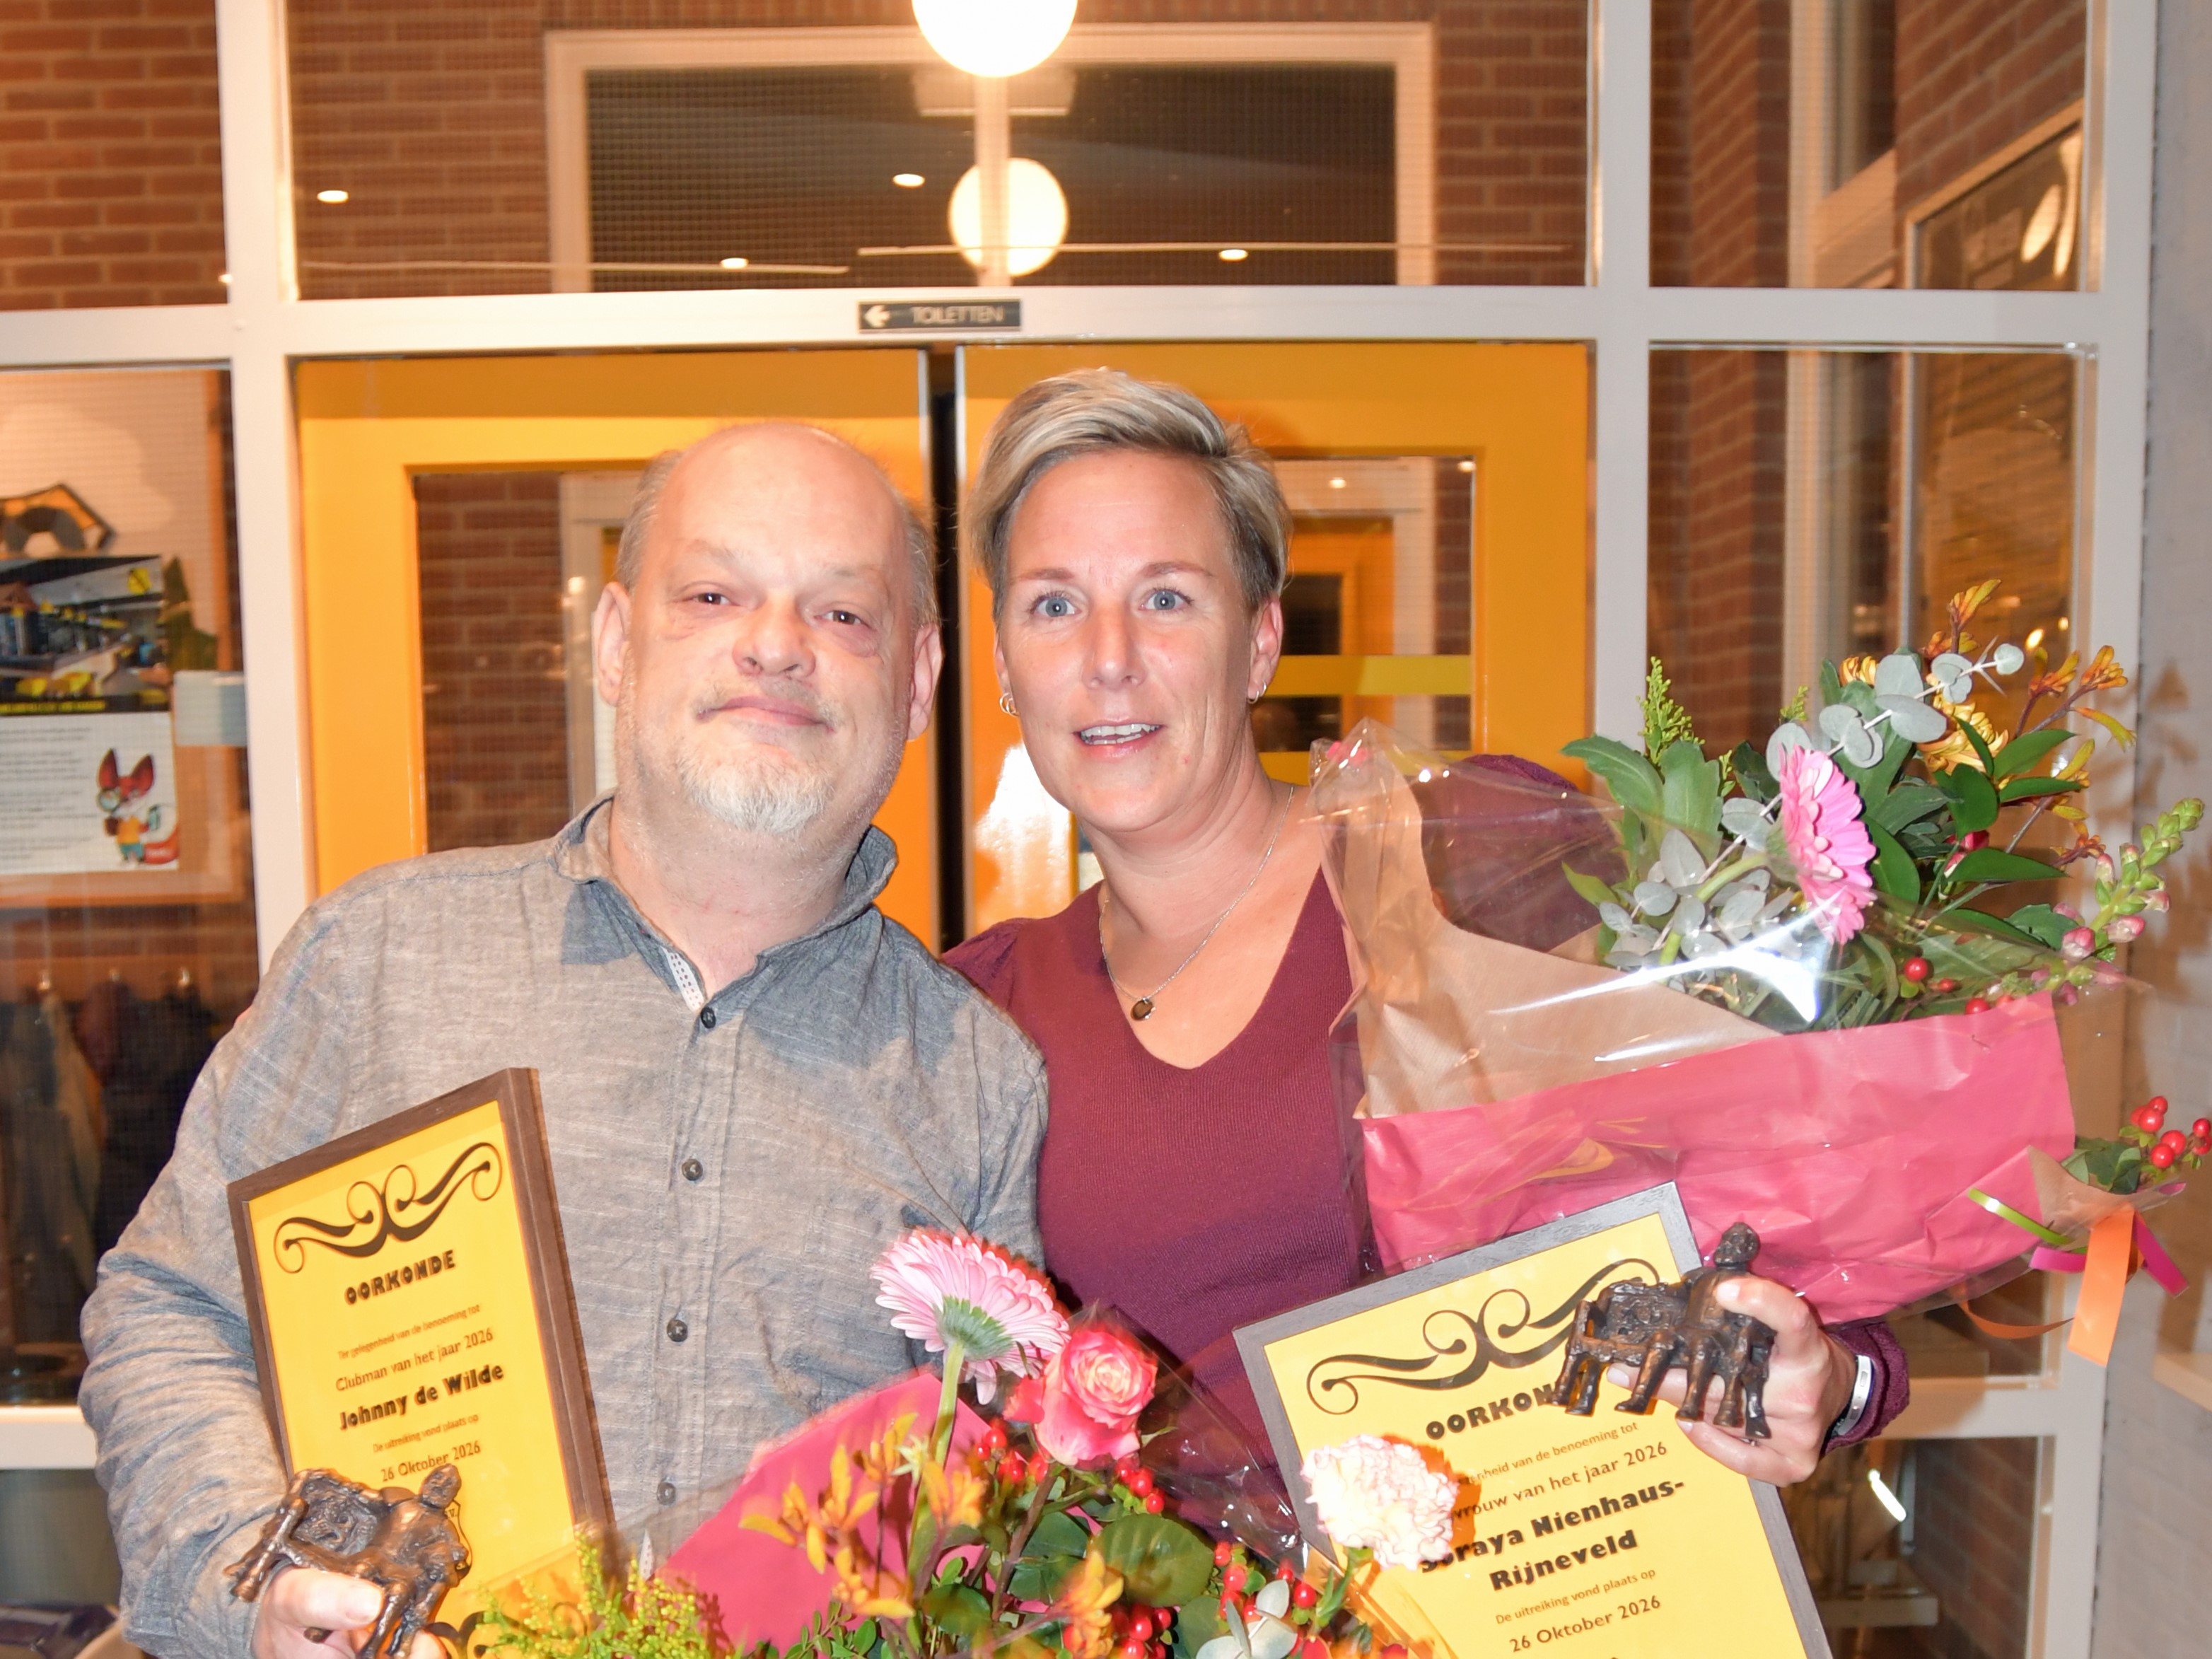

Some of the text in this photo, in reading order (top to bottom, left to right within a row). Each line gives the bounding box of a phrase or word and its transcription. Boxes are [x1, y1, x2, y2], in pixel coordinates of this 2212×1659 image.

[912, 305, 1005, 325] TOILETTEN
[344, 1250, 455, 1305] OORKONDE
[396, 1329, 410, 1339] van
[412, 1325, 421, 1334] de
[423, 1309, 467, 1330] benoeming
[468, 1303, 480, 1315] tot
[336, 1327, 494, 1391] Clubman van het jaar 2026
[339, 1364, 504, 1431] Johnny de Wilde
[1426, 1382, 1559, 1440] OORKON
[373, 1443, 383, 1453] De
[422, 1425, 441, 1437] vond
[443, 1417, 467, 1433] plaats
[468, 1414, 479, 1424] op
[380, 1440, 482, 1483] 26 Oktober 2026
[1511, 1455, 1533, 1470] van
[1536, 1449, 1550, 1462] de
[1552, 1428, 1619, 1456] benoeming
[1620, 1421, 1639, 1436] tot
[1453, 1441, 1667, 1519] vrouw van het jaar 2026
[1530, 1480, 1684, 1539] Nienhaus-
[1489, 1529, 1638, 1592] Rijneveld
[1495, 1568, 1656, 1625] De uitreiking vond plaats op
[1509, 1595, 1661, 1653] 26 Oktober 2026
